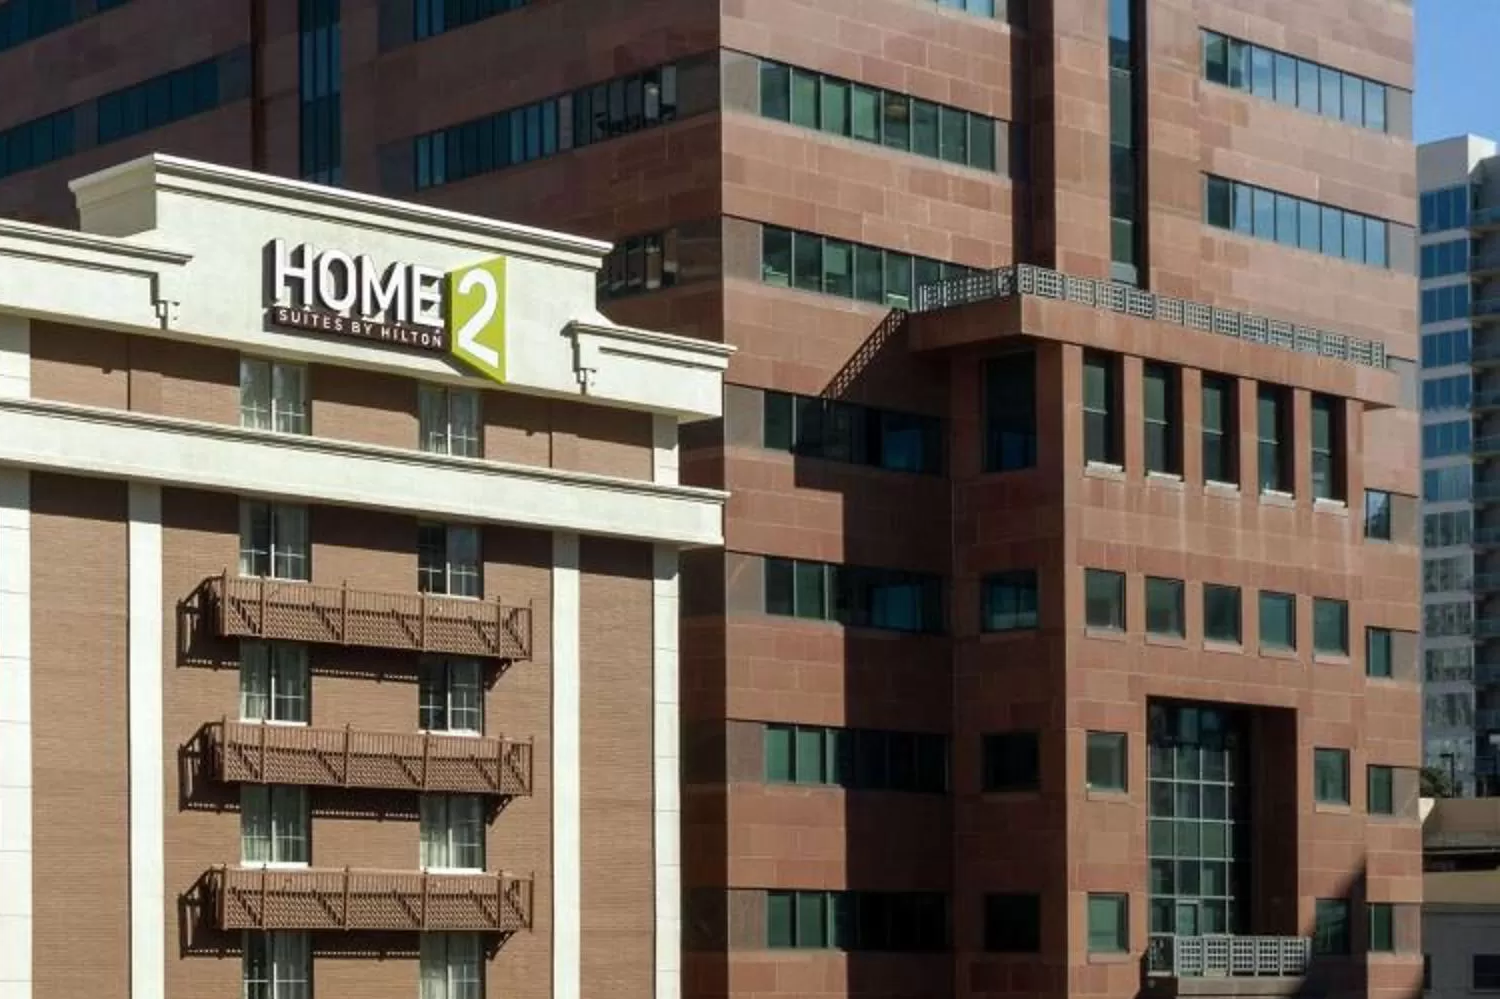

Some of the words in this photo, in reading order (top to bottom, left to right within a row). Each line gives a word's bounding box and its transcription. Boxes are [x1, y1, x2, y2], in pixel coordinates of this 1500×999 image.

[272, 238, 444, 327] HOME
[457, 267, 500, 369] 2
[278, 309, 343, 331] SUITES
[351, 321, 373, 335] BY
[380, 326, 443, 347] HILTON
